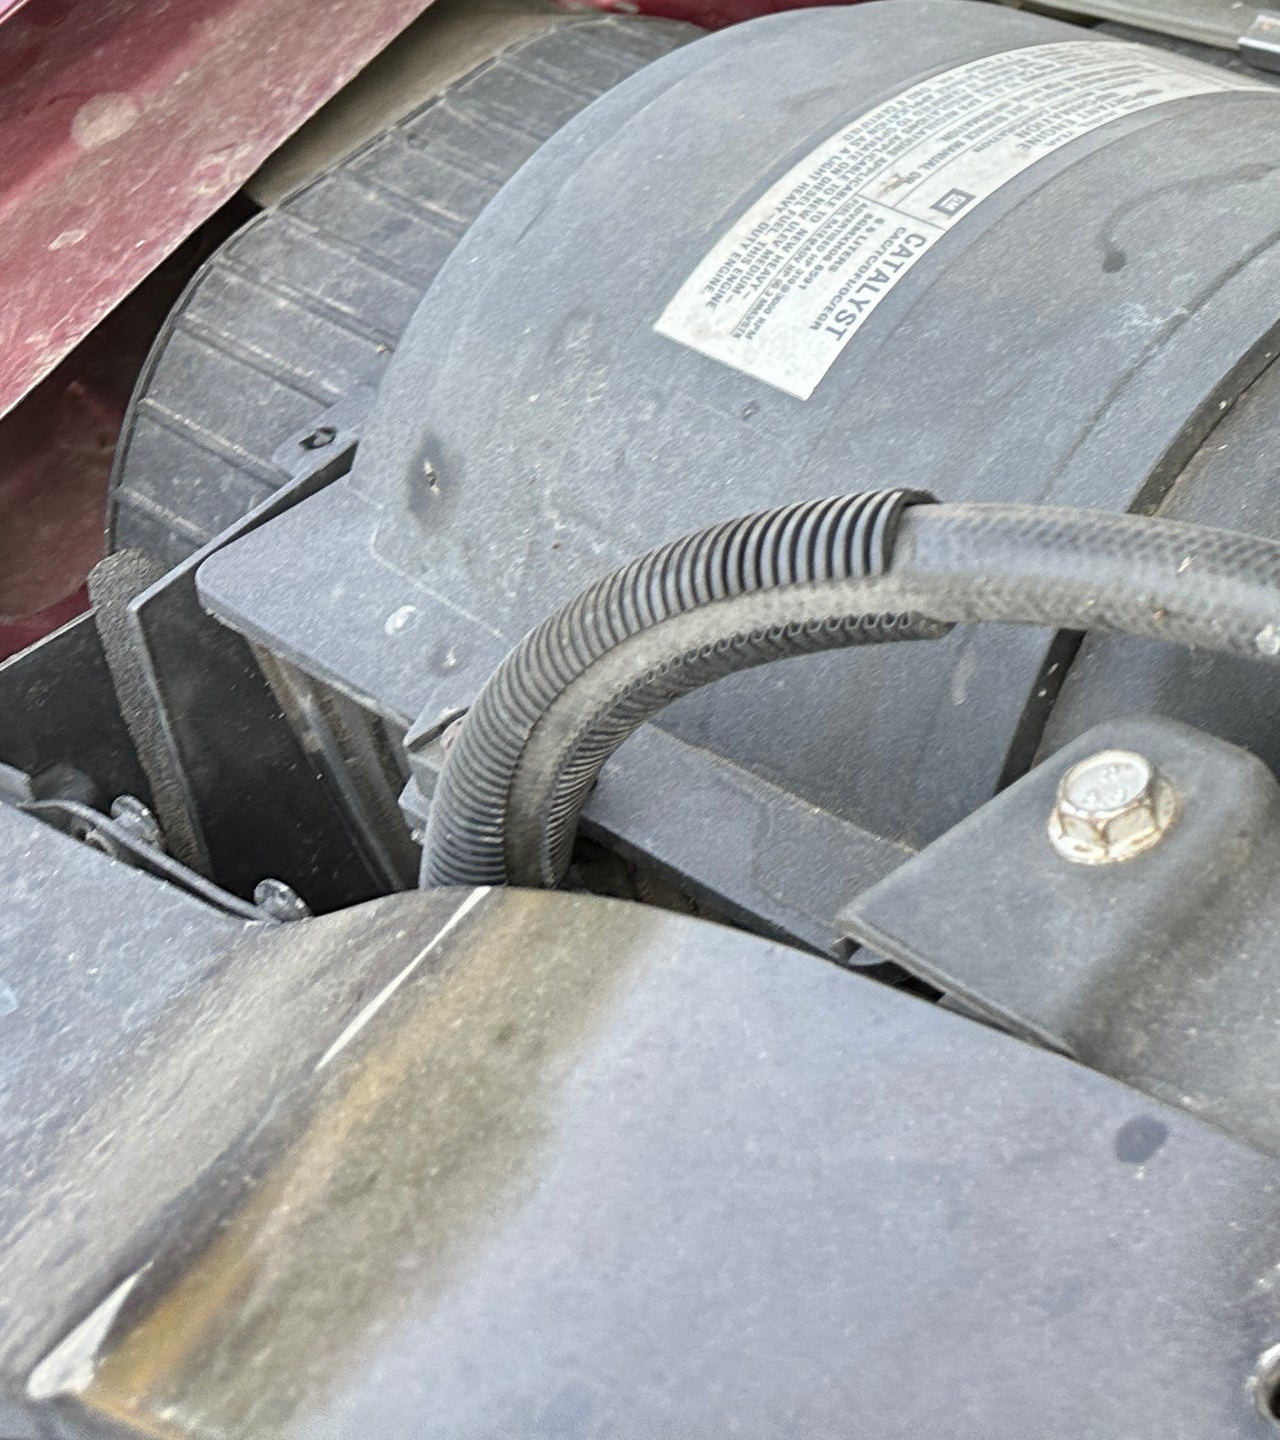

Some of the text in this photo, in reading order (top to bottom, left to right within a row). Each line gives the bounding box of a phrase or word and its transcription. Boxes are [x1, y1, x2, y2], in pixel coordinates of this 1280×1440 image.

[841, 104, 897, 142] CERTIFIED
[839, 147, 850, 156] A
[849, 135, 867, 148] AS
[807, 153, 842, 181] LIGHT
[829, 160, 850, 176] ON
[771, 134, 901, 247] APPLICABLE TO NEW ULEV
[792, 175, 832, 208] DIESEL
[823, 157, 886, 209] APPLICABLE
[808, 209, 827, 224] TO
[739, 239, 767, 265] THIS
[780, 227, 808, 253] NEW
[826, 234, 865, 273] LITERS
[743, 202, 867, 340] ADVERTISED HP RPM
[779, 263, 795, 277] HP
[823, 230, 929, 337] CATALYST
[704, 267, 743, 309] ENGINE
